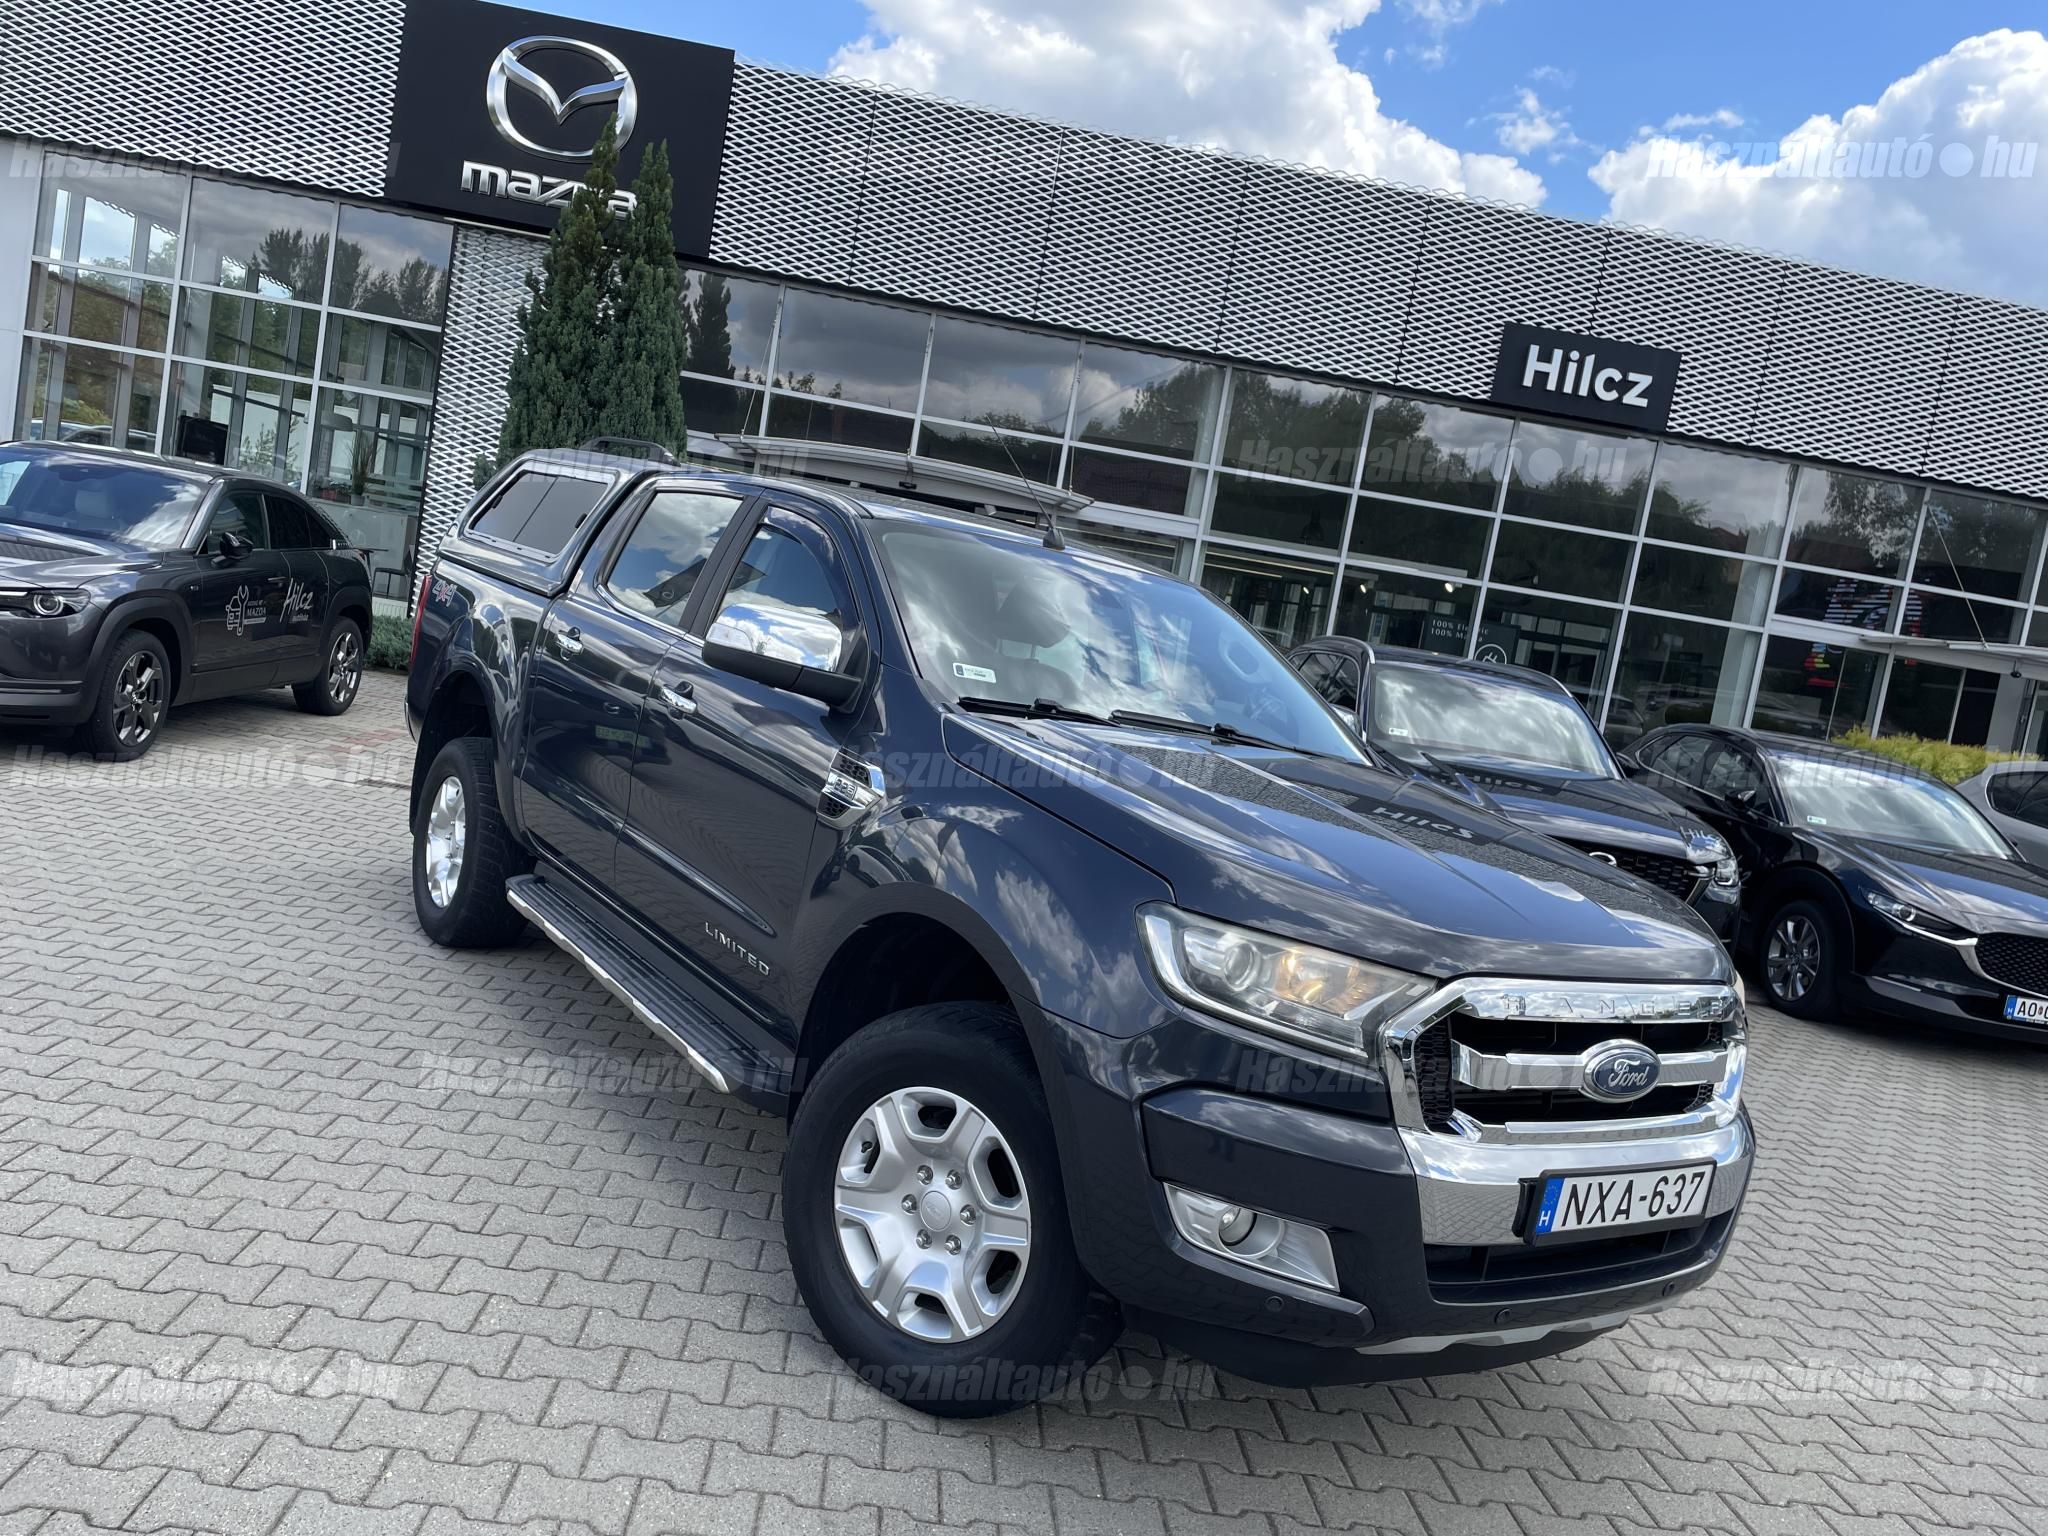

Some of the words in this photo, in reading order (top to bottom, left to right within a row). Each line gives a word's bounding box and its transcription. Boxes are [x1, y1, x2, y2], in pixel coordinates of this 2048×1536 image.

[1522, 344, 1653, 408] Hilcz
[1431, 627, 1453, 638] 100%
[1432, 619, 1454, 630] 100%
[705, 921, 770, 976] LIMITED
[1608, 1058, 1650, 1087] Ford
[1538, 1210, 1551, 1227] H
[1561, 1171, 1706, 1227] NXA-637
